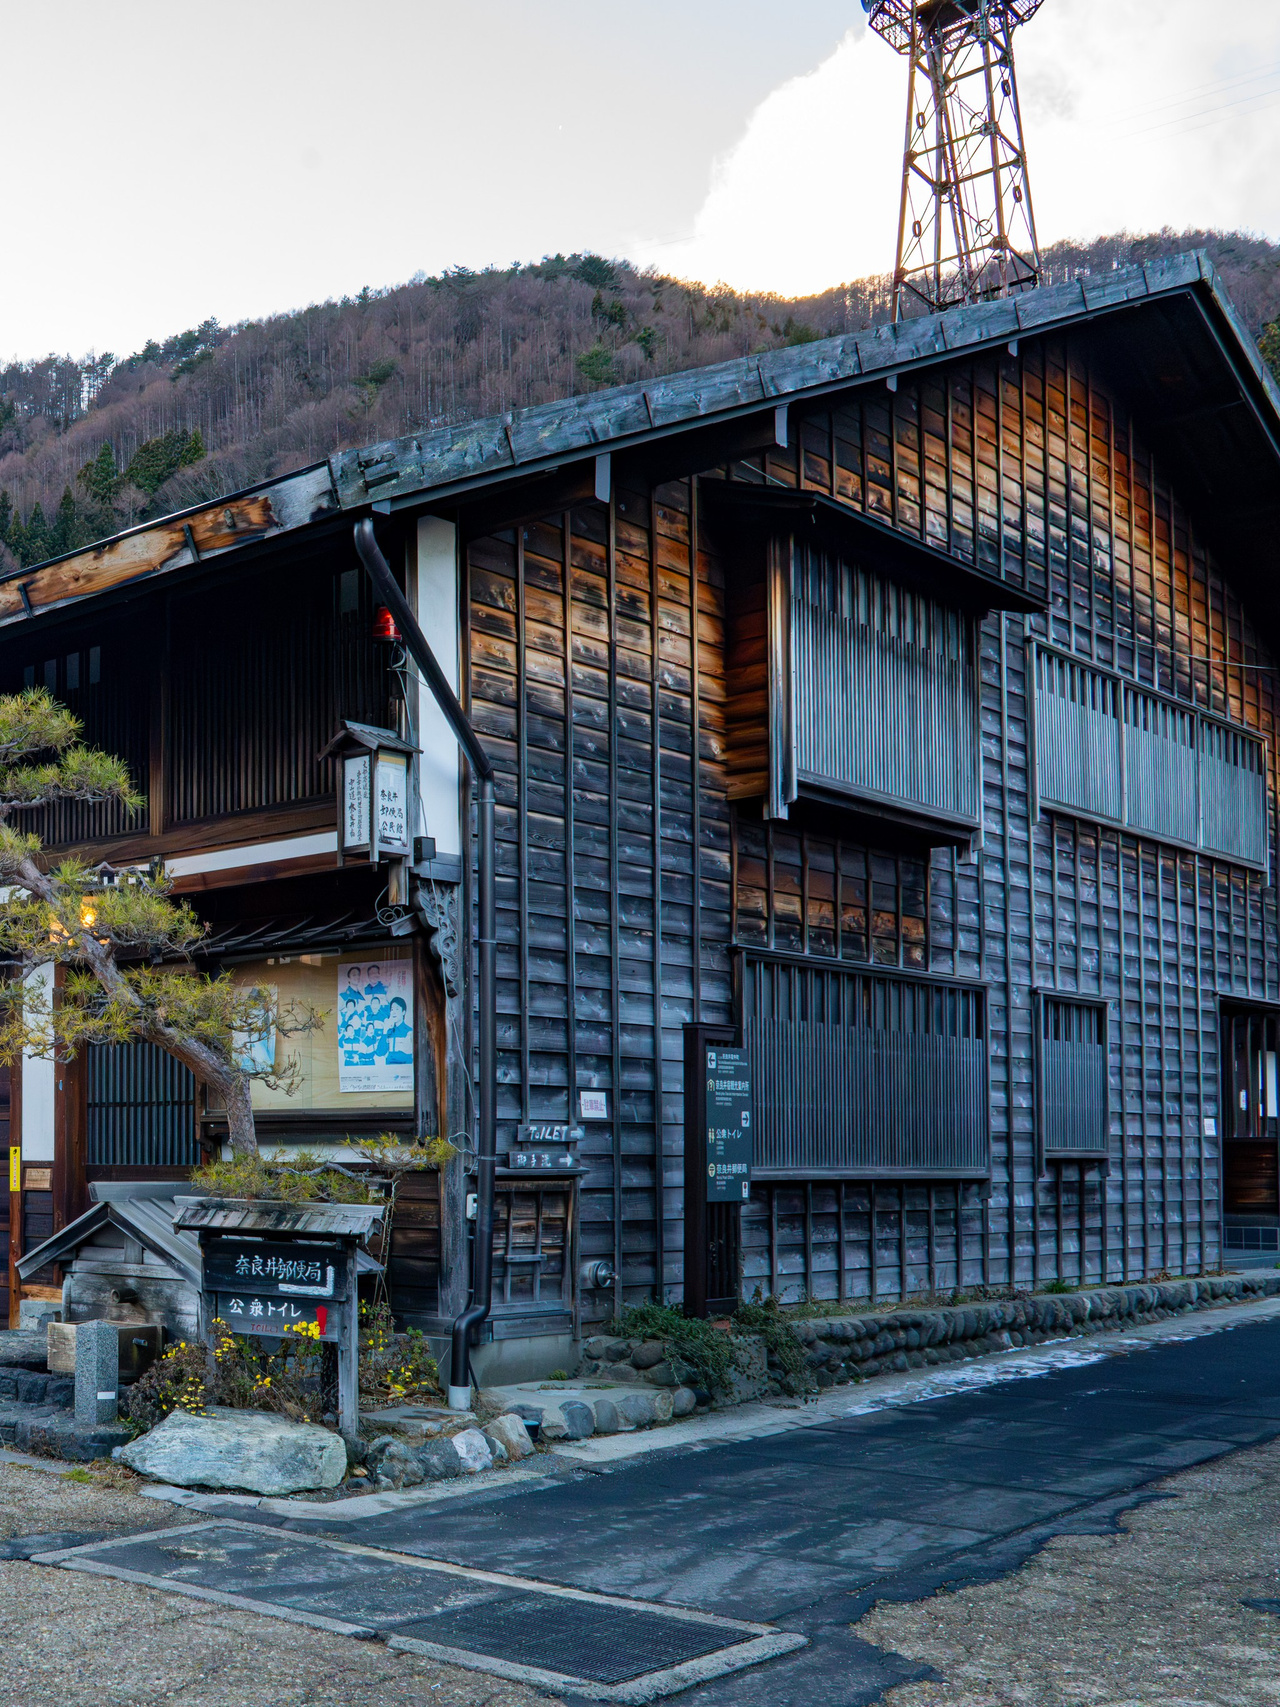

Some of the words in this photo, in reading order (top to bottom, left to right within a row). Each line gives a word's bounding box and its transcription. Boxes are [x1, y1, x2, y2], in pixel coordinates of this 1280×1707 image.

[716, 1128, 742, 1139] 公衆トイレ
[235, 1254, 321, 1282] 奈良井郵便局
[229, 1298, 302, 1317] 公衆トイレ
